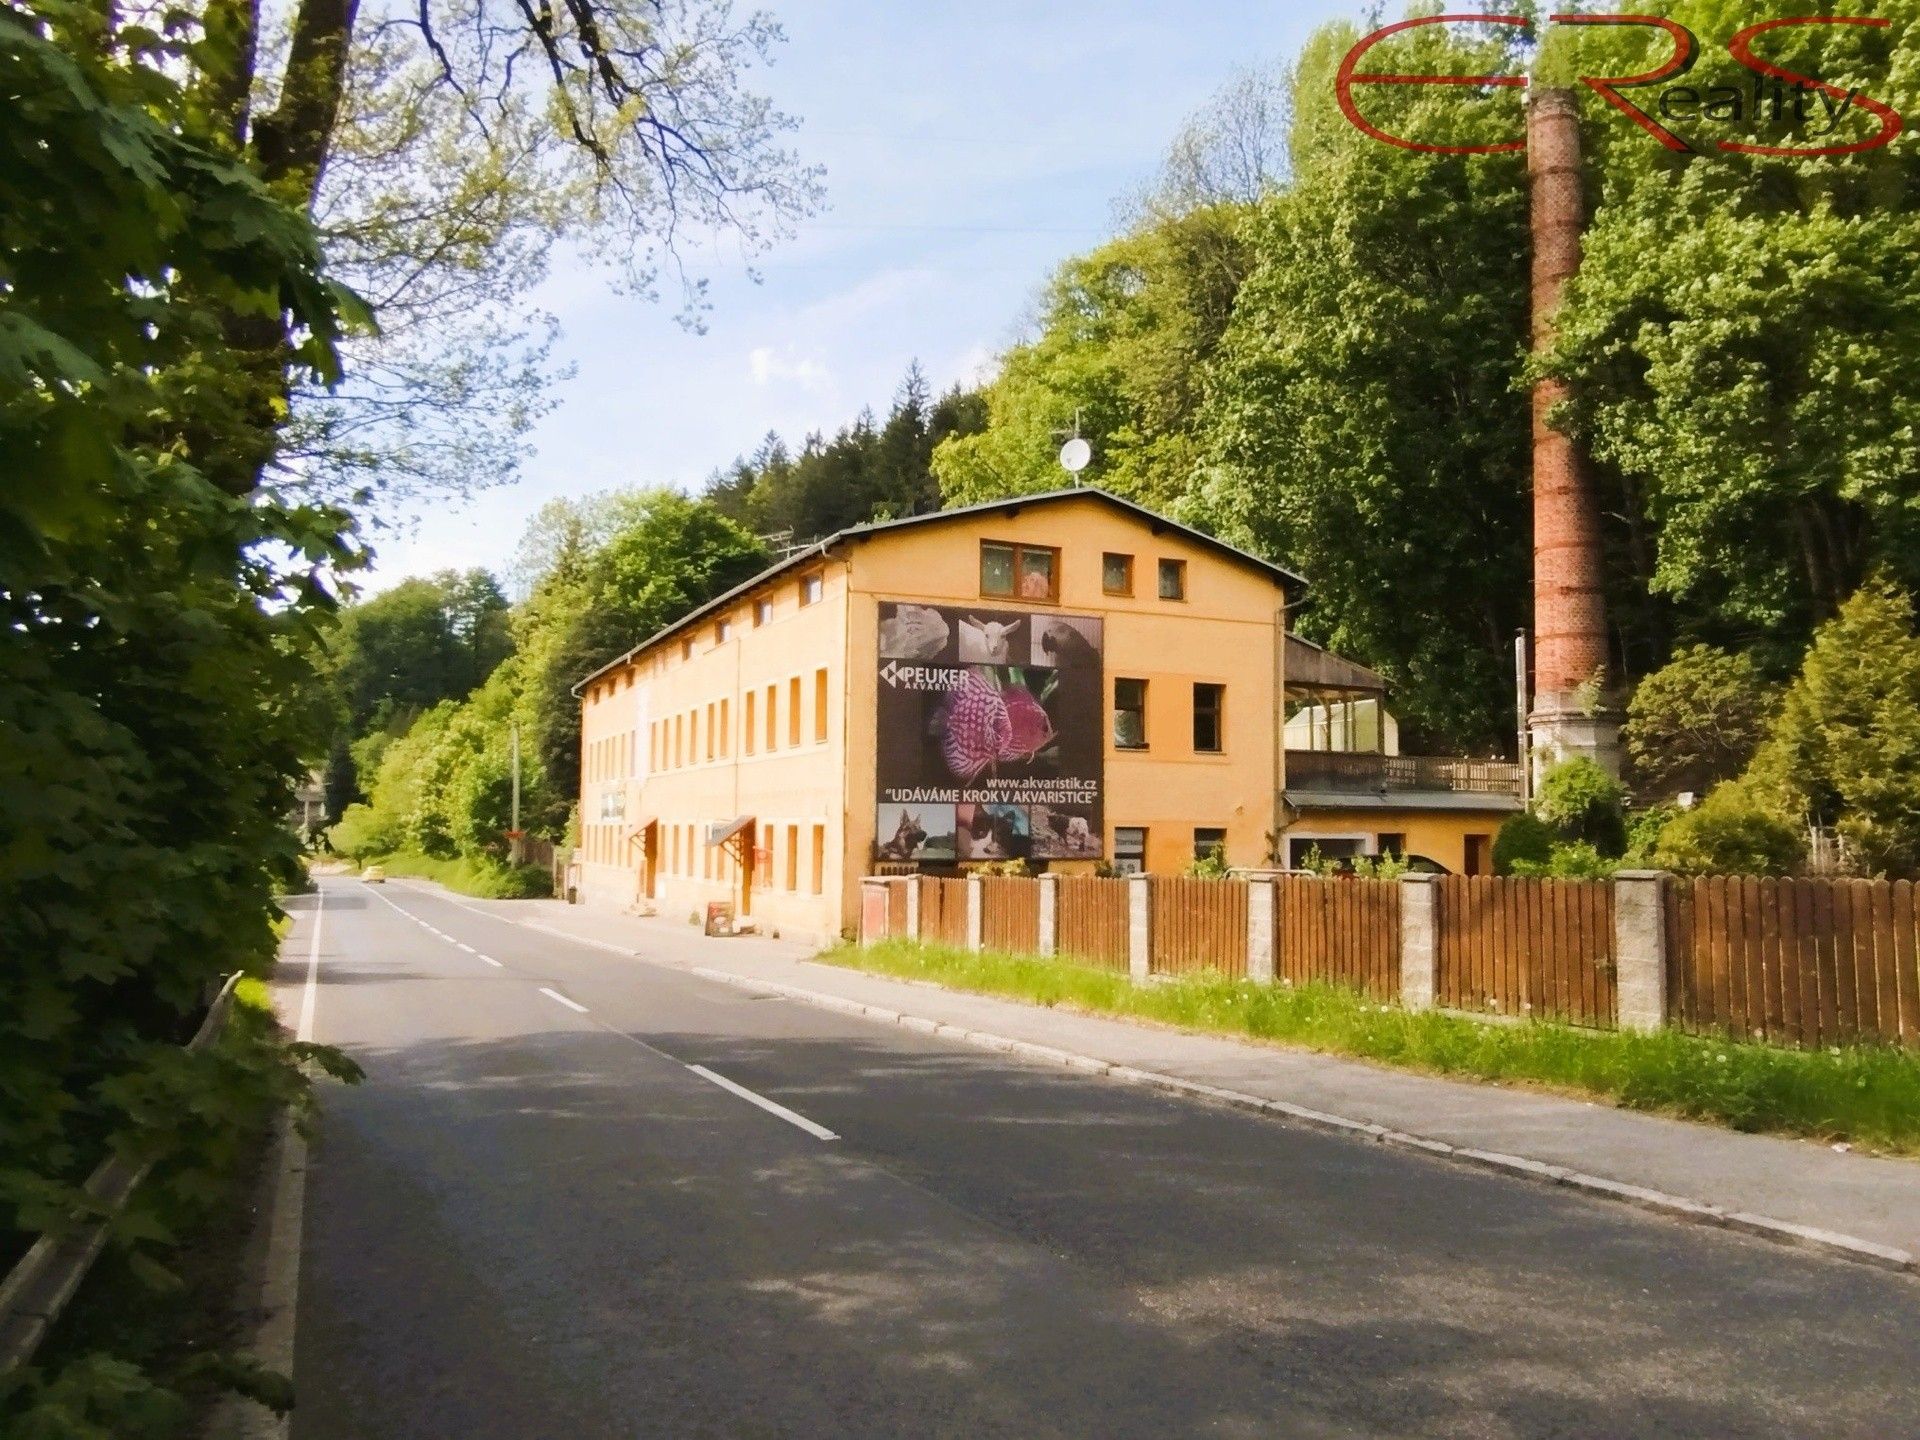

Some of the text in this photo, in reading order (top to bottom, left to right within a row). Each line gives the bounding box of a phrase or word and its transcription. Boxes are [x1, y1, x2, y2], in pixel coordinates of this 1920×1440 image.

[903, 666, 970, 685] PEUKER
[986, 776, 1097, 790] www.akvaristik.cz
[962, 788, 999, 803] KROK
[1001, 790, 1010, 803] V
